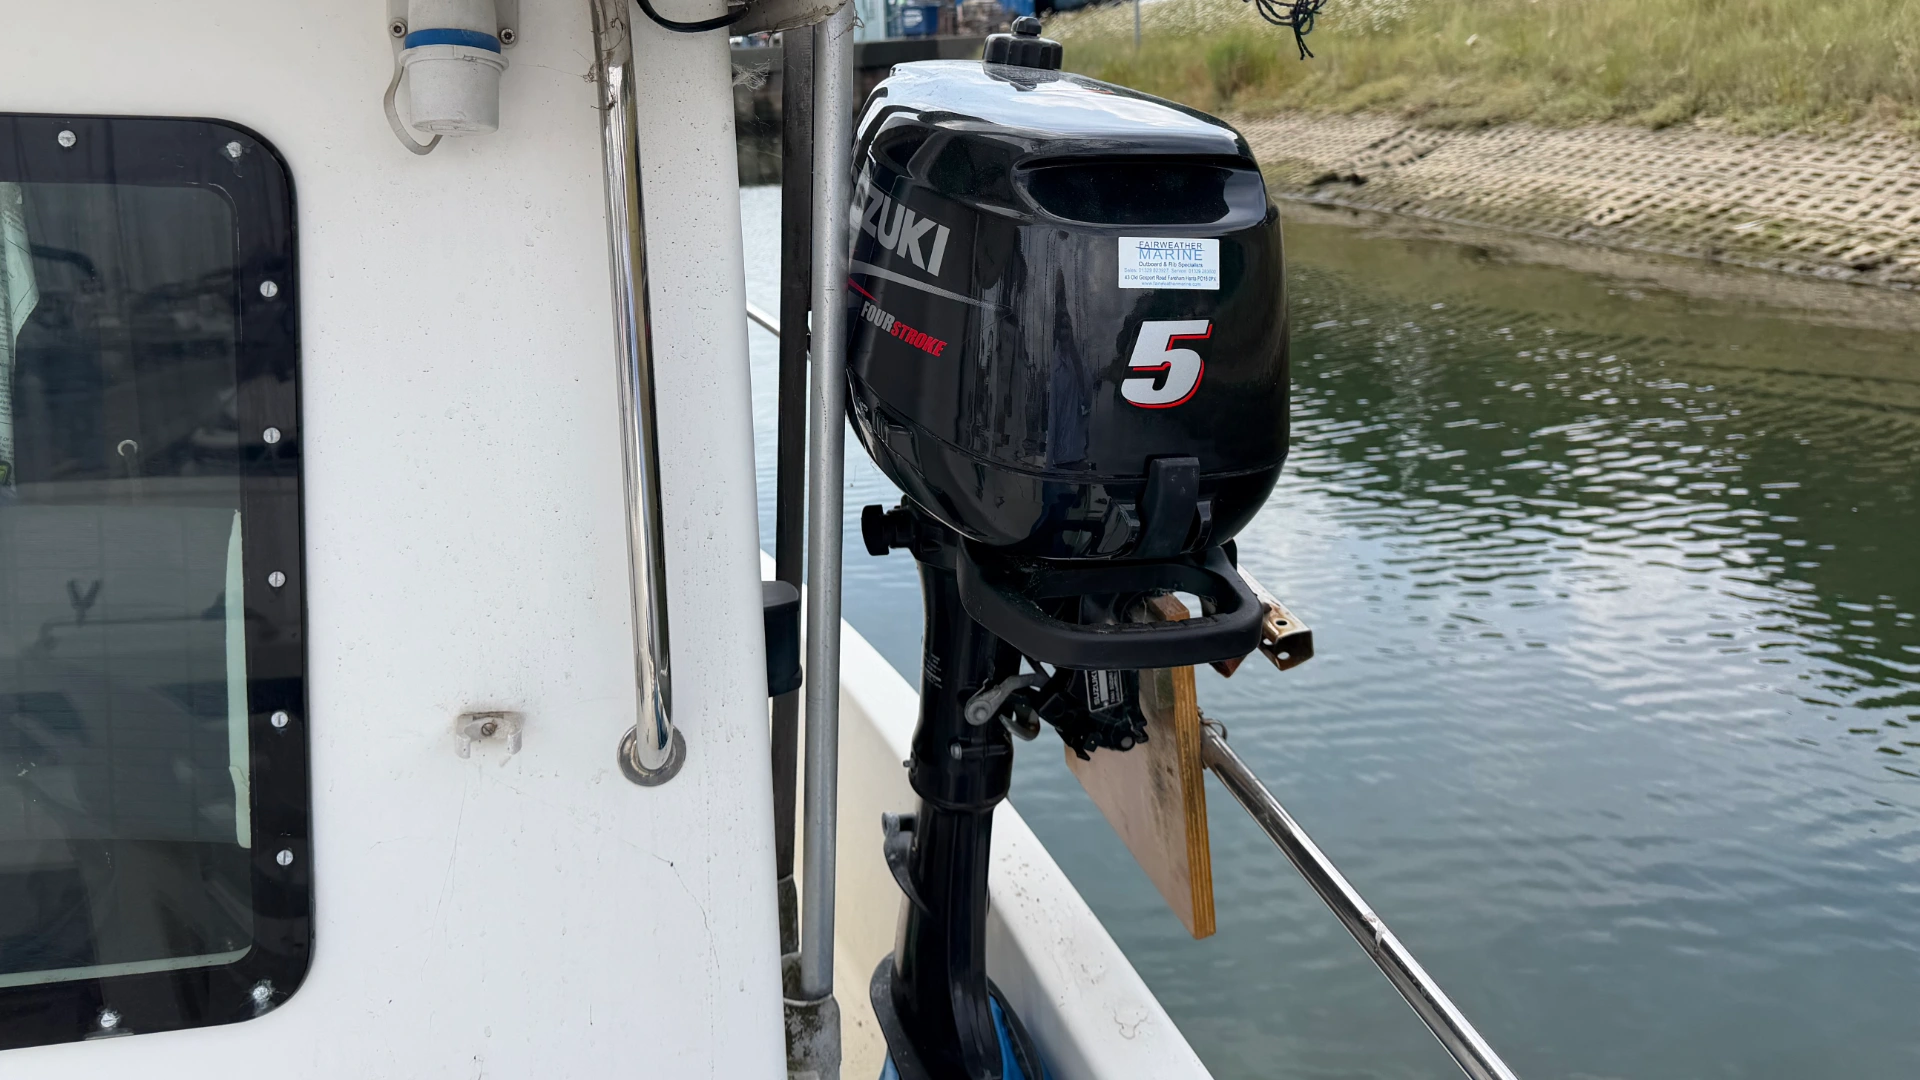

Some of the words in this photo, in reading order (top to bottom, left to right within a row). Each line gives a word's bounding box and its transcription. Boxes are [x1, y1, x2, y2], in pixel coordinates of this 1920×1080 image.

[1139, 240, 1203, 250] FAIRWEATHER
[1139, 249, 1203, 261] MARINE
[860, 301, 948, 357] FOURSTROKE
[1120, 319, 1213, 409] 5
[1090, 670, 1101, 706] SUZUKI
